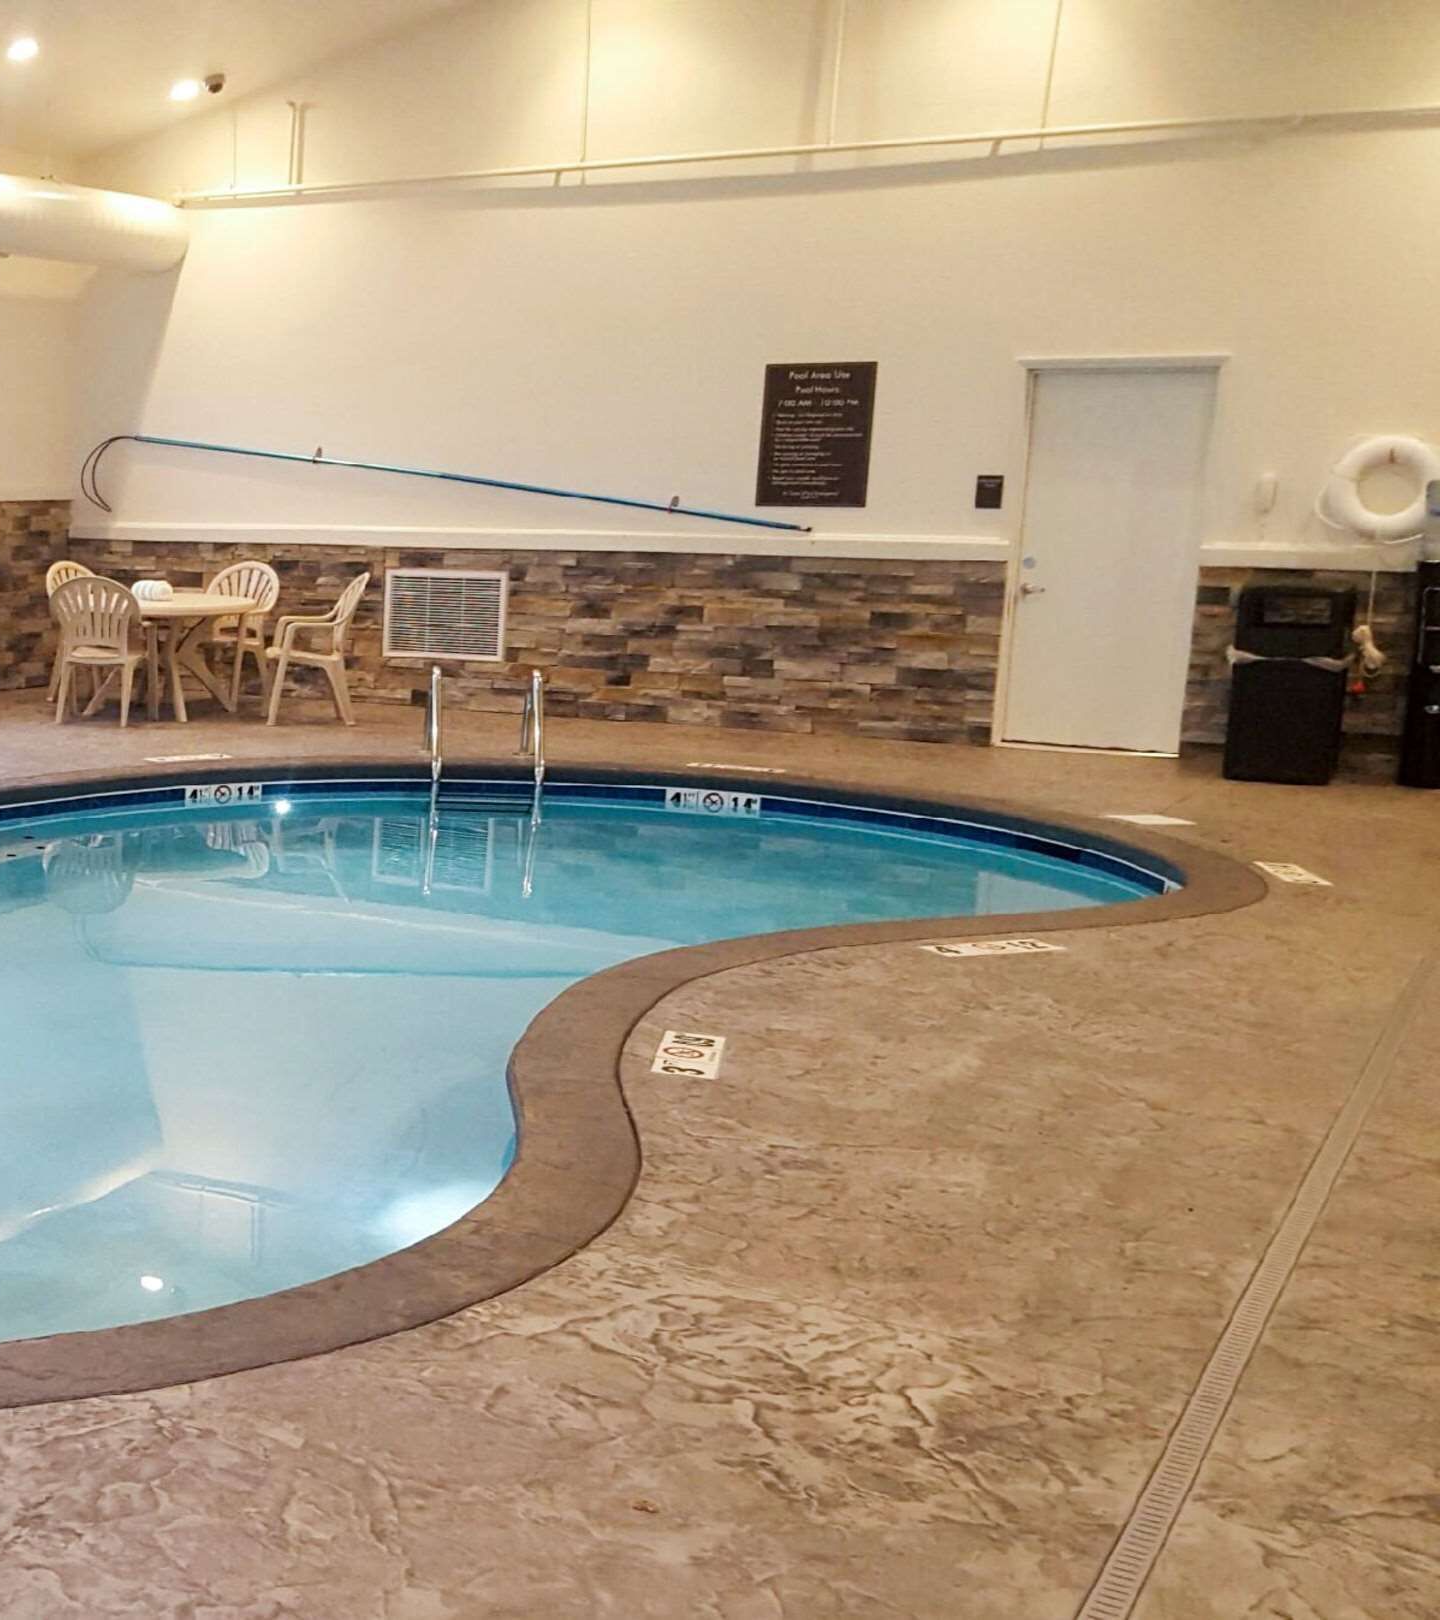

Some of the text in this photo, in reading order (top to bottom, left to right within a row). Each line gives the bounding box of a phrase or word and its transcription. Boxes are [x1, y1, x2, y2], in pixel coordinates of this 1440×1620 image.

[789, 370, 851, 380] Pool Area Use
